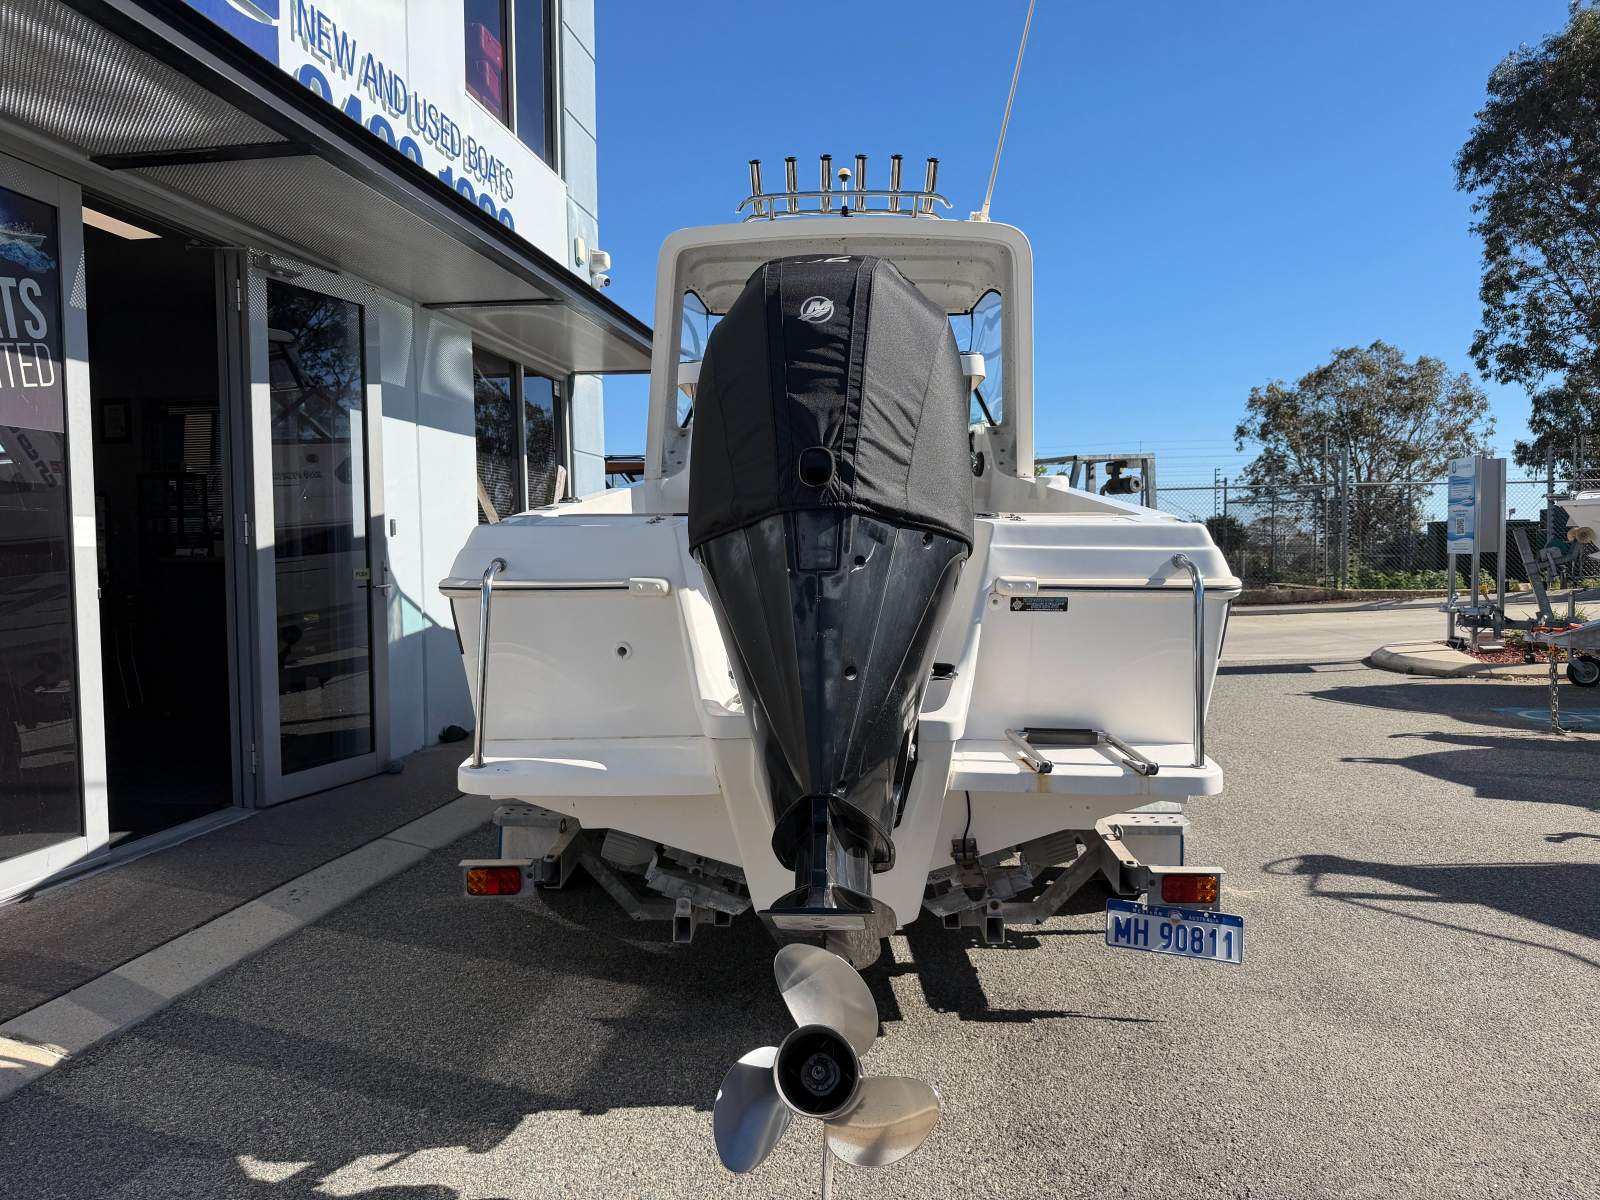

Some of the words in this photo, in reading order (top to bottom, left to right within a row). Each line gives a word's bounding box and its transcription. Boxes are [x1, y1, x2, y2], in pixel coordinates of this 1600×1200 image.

[297, 0, 357, 77] NEW
[363, 52, 408, 115] AND
[414, 91, 462, 158] USED
[467, 134, 514, 200] BOATS
[0, 276, 48, 340] TS
[0, 342, 55, 388] TED
[1114, 915, 1149, 947] MH
[1159, 922, 1233, 960] 90811
